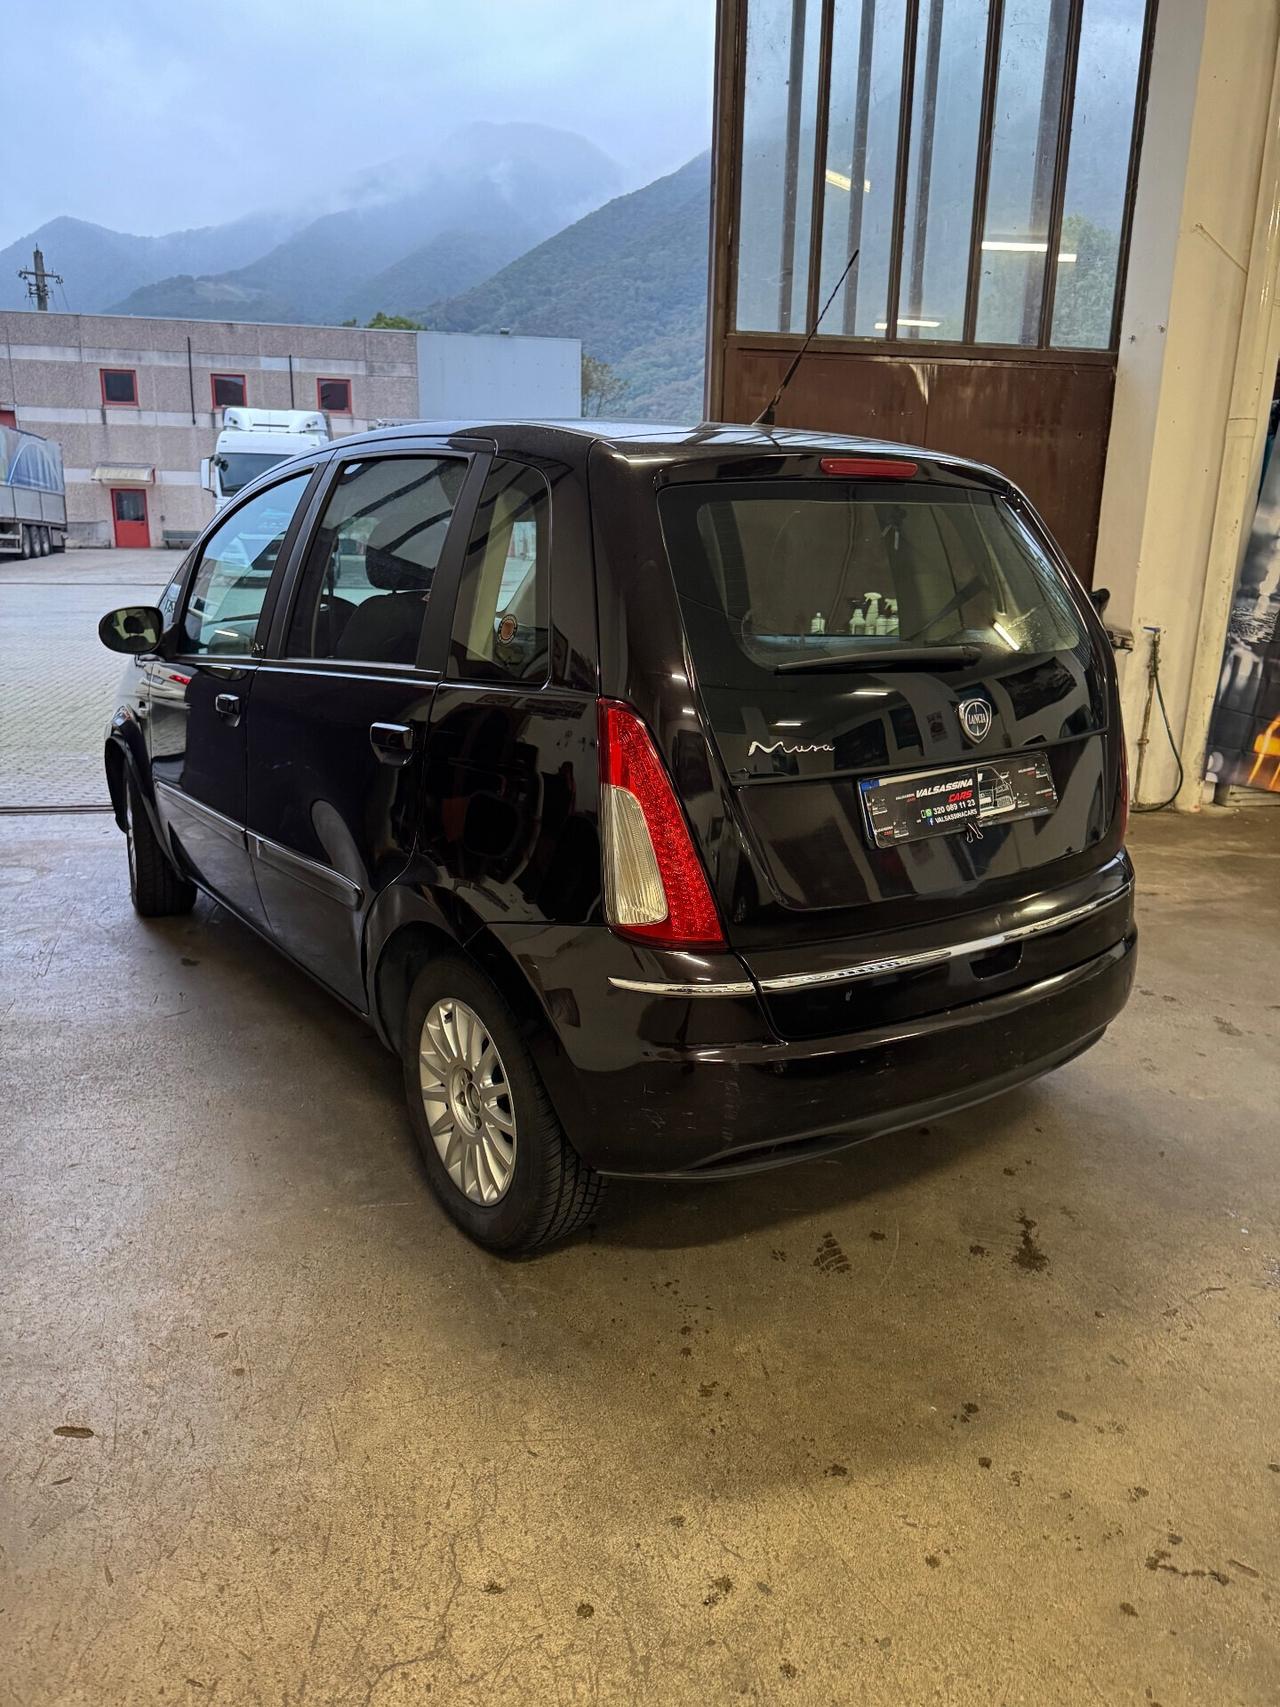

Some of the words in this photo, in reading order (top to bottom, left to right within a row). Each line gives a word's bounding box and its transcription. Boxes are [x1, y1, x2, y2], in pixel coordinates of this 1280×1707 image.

[968, 713, 986, 725] LANCIA
[747, 741, 836, 757] Musa
[916, 778, 973, 798] VALSASSINA
[948, 790, 973, 803] CARS
[933, 806, 946, 815] 320
[959, 801, 966, 809] 11
[967, 799, 976, 807] 23
[935, 809, 977, 823] VALSASSINACARS
